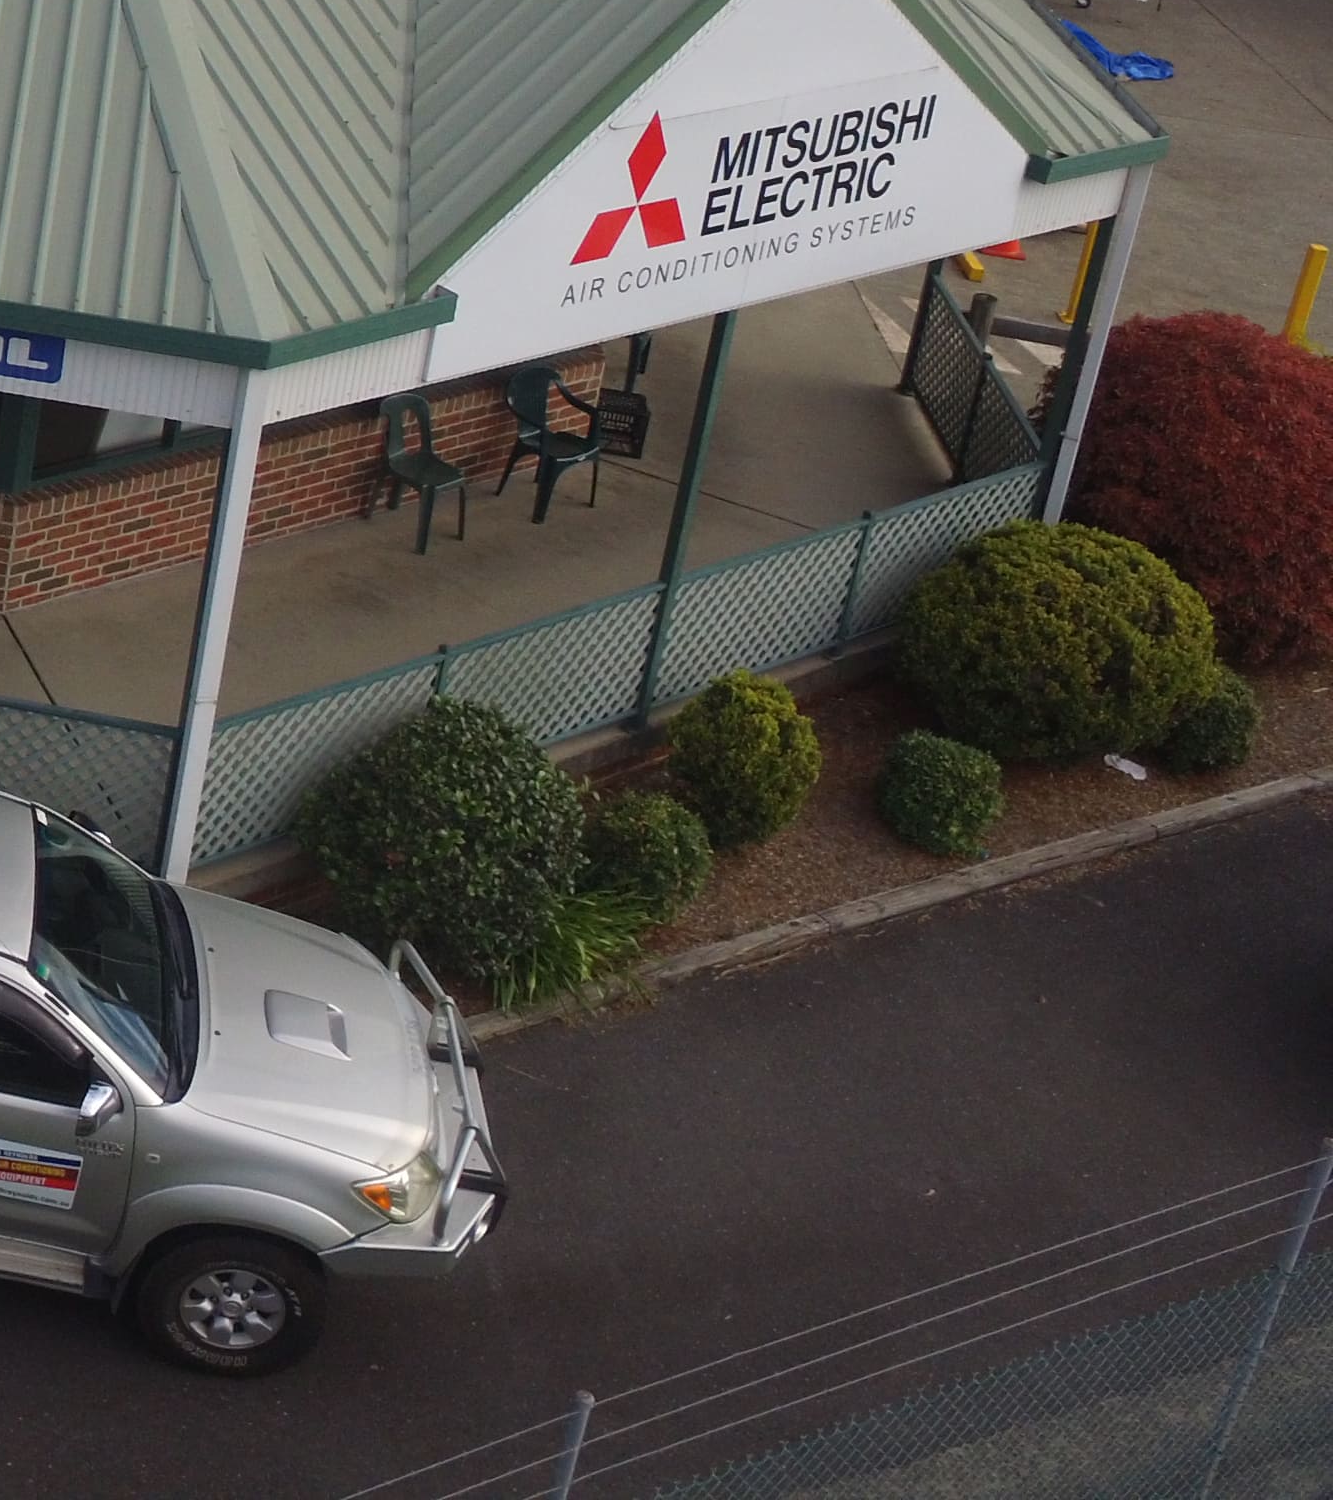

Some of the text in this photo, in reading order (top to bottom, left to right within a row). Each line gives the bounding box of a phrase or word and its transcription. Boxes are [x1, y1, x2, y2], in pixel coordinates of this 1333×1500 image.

[711, 94, 938, 184] MITSUBISHI
[700, 153, 896, 237] ELECTRIC
[560, 205, 916, 308] AIR CONDITIONING SYSTEMS
